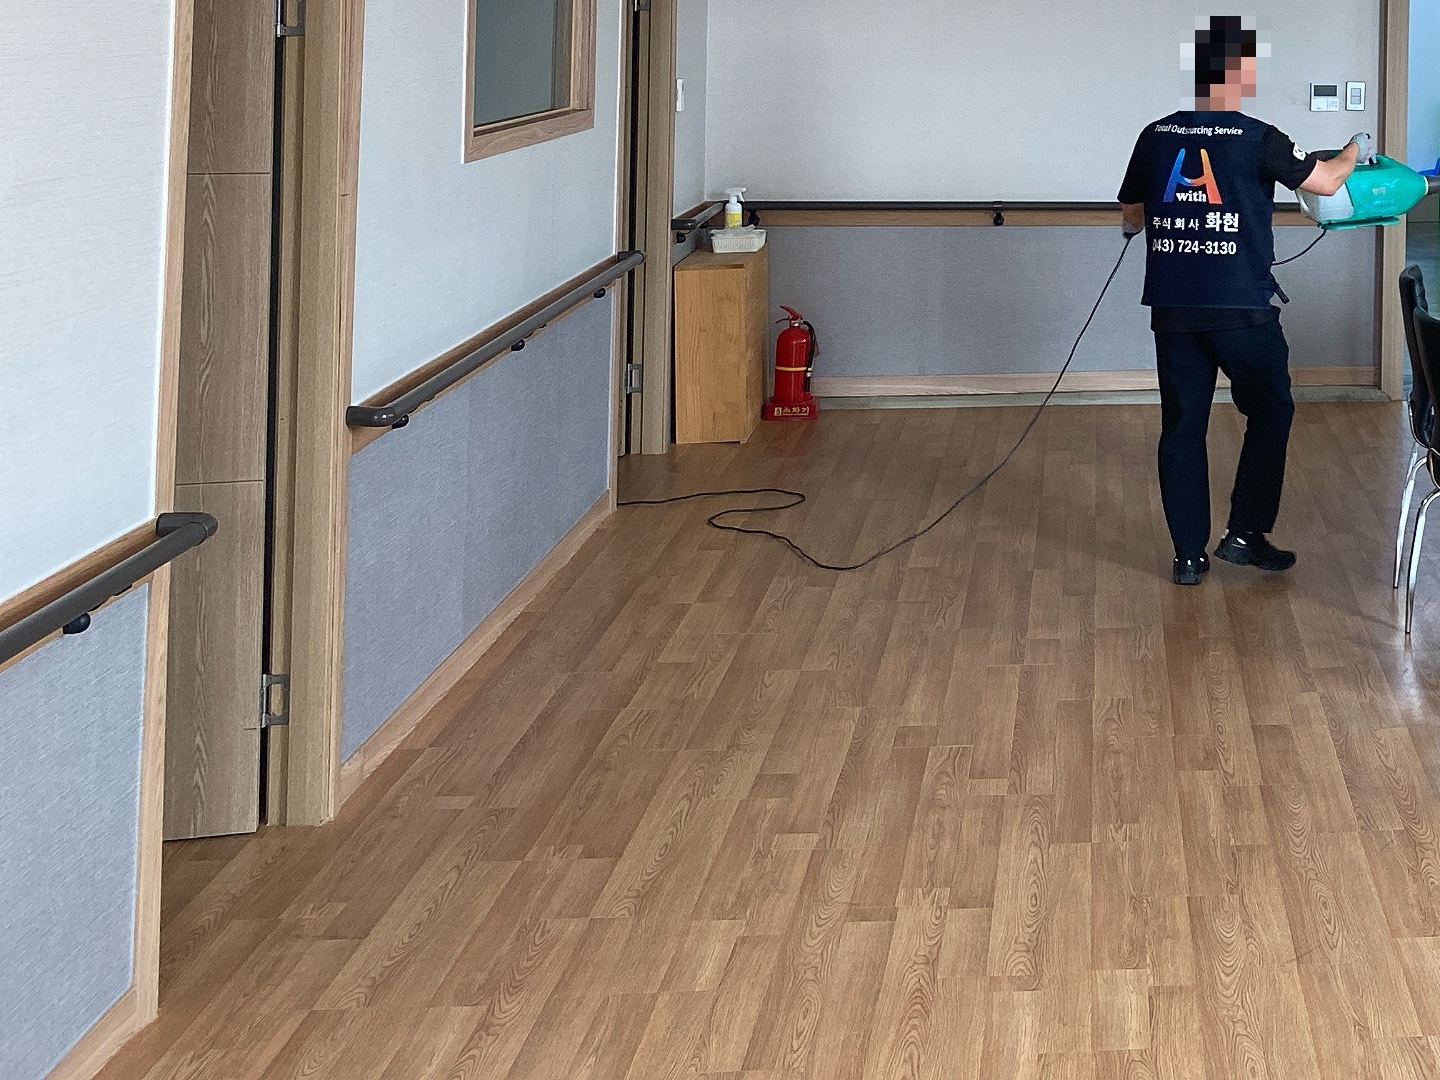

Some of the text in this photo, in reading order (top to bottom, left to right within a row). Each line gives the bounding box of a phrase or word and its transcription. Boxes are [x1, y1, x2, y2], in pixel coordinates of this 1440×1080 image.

[1214, 126, 1243, 135] Service
[1176, 190, 1207, 202] with
[1205, 211, 1239, 232] 화현
[1177, 239, 1237, 255] 724-3130
